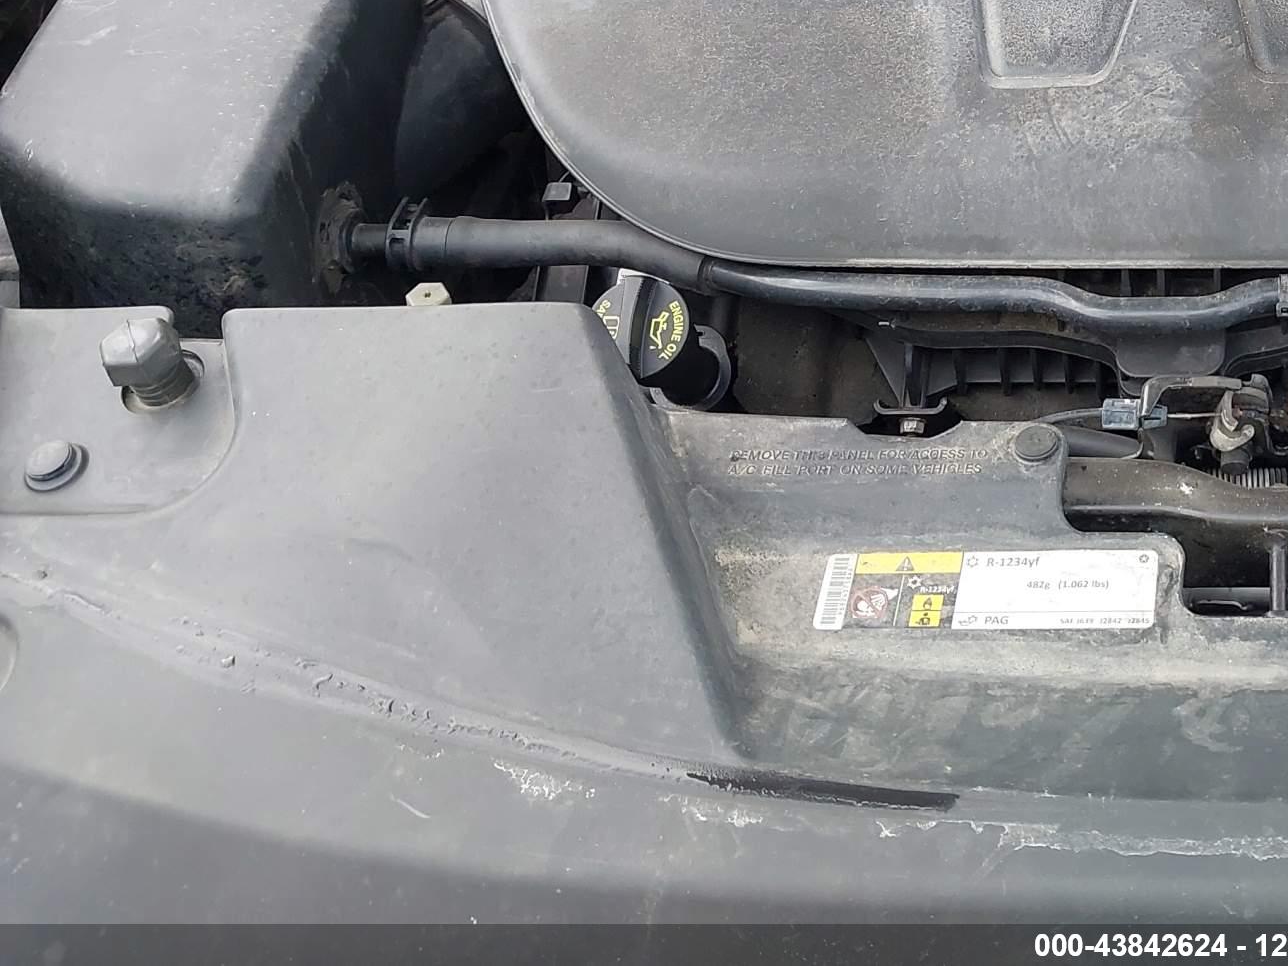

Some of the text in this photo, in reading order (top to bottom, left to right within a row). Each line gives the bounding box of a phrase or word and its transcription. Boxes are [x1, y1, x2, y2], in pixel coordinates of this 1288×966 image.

[596, 299, 611, 318] SA
[658, 300, 684, 360] ENGINE OIL
[986, 557, 1040, 569] R-1234yf
[1026, 580, 1110, 591] 482g (1.062 lbs)
[984, 616, 1009, 625] PAG
